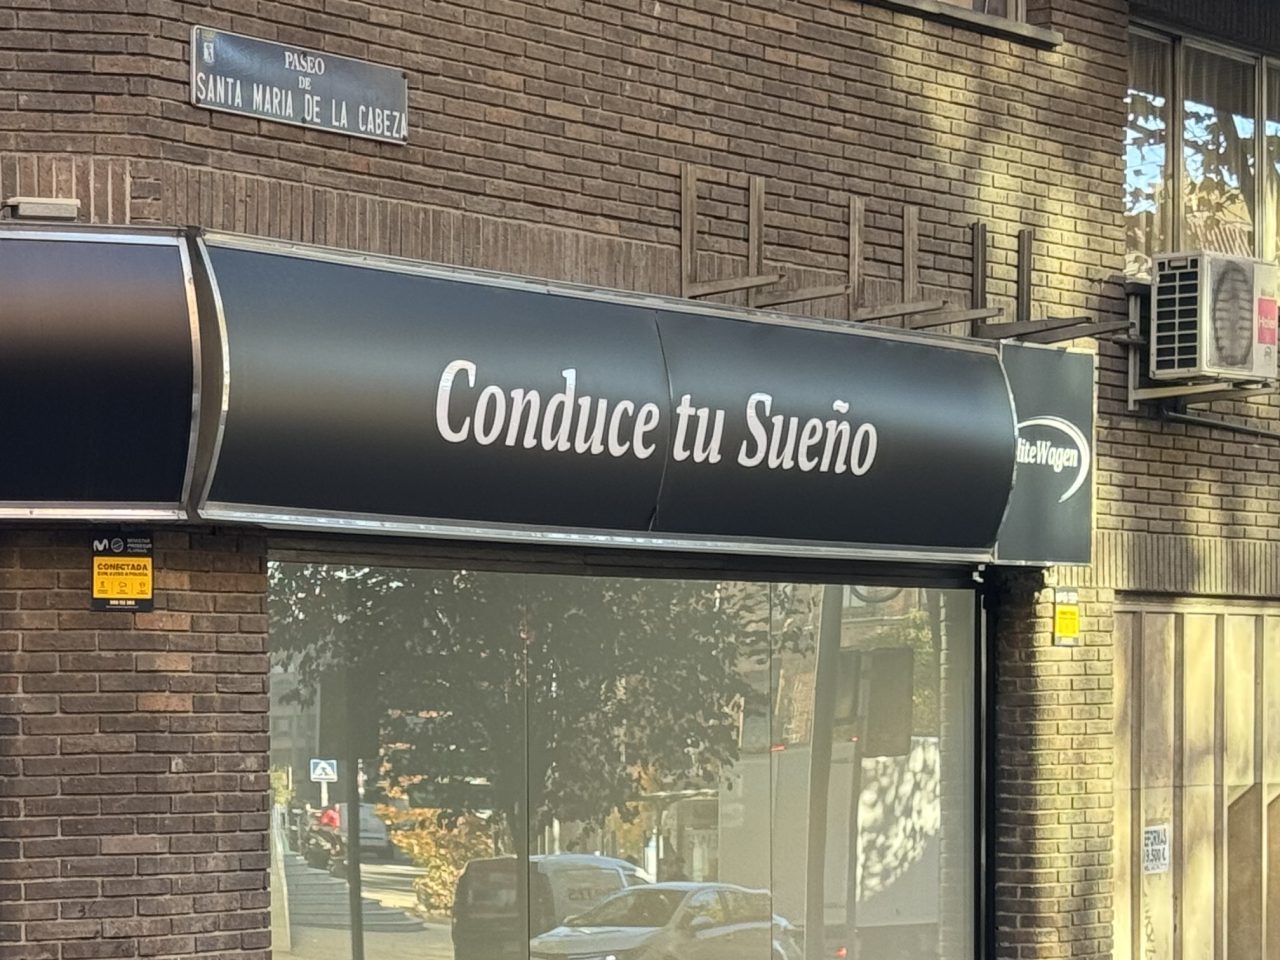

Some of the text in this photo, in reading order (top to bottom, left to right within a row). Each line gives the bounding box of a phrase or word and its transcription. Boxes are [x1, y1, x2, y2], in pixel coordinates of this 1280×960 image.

[284, 51, 325, 75] PASEO
[298, 76, 311, 90] DE
[196, 72, 408, 138] SANTA MARIA DE LA CABEZA
[435, 359, 877, 476] Conduce tu Sueño
[1016, 437, 1079, 473] liteWagen
[97, 562, 149, 571] CONECTADA
